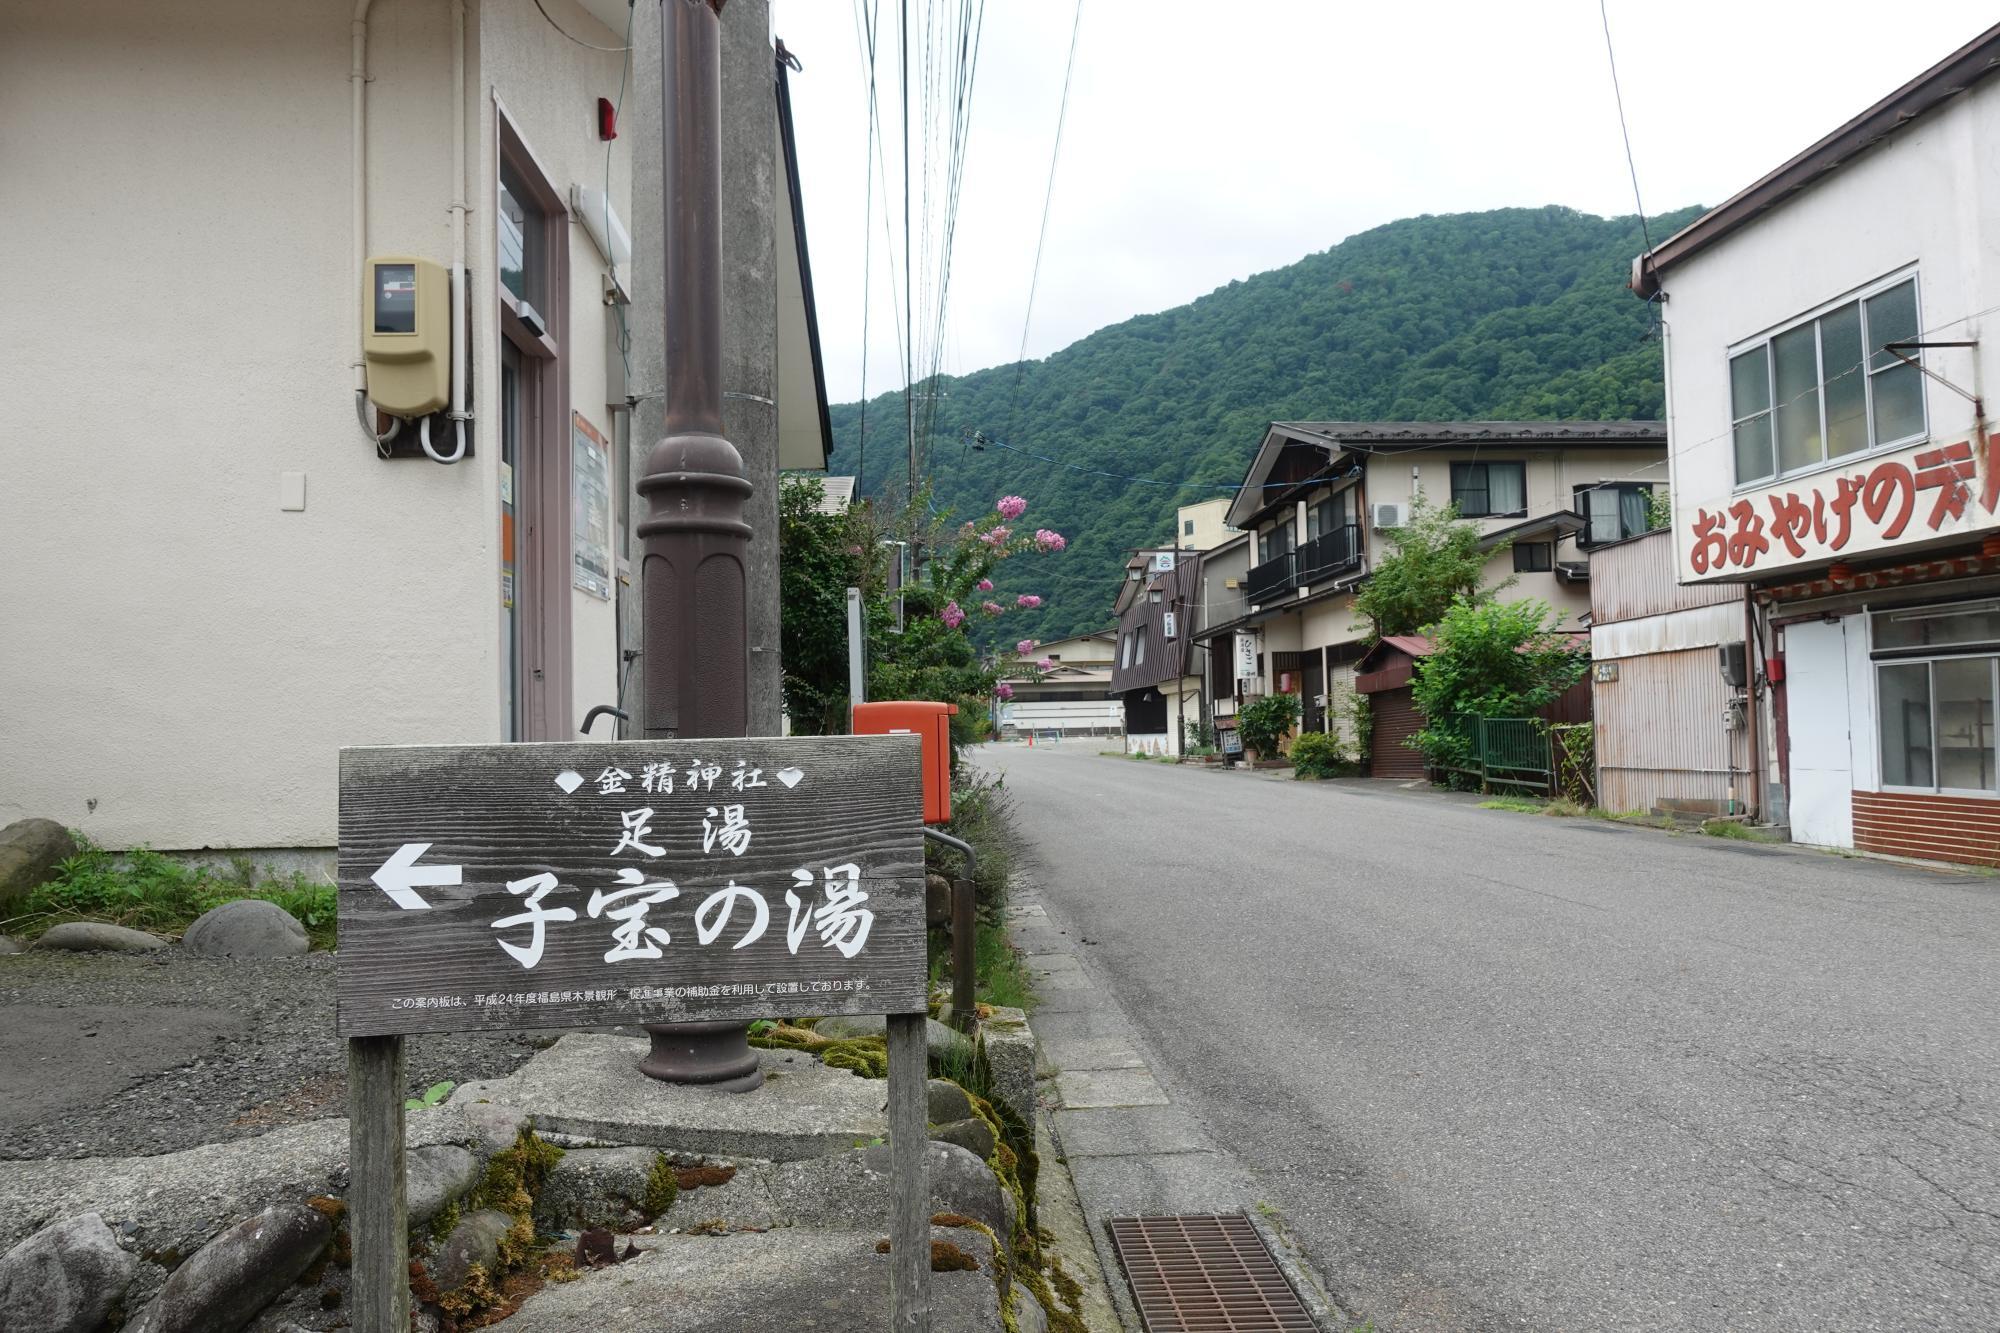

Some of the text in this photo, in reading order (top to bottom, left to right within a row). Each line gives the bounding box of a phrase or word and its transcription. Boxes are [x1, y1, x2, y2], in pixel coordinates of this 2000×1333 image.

[1690, 432, 2000, 576] おみやげのデ
[594, 759, 767, 795] 金精神社
[610, 803, 752, 858] 足湯
[490, 862, 875, 969] 子宝の湯
